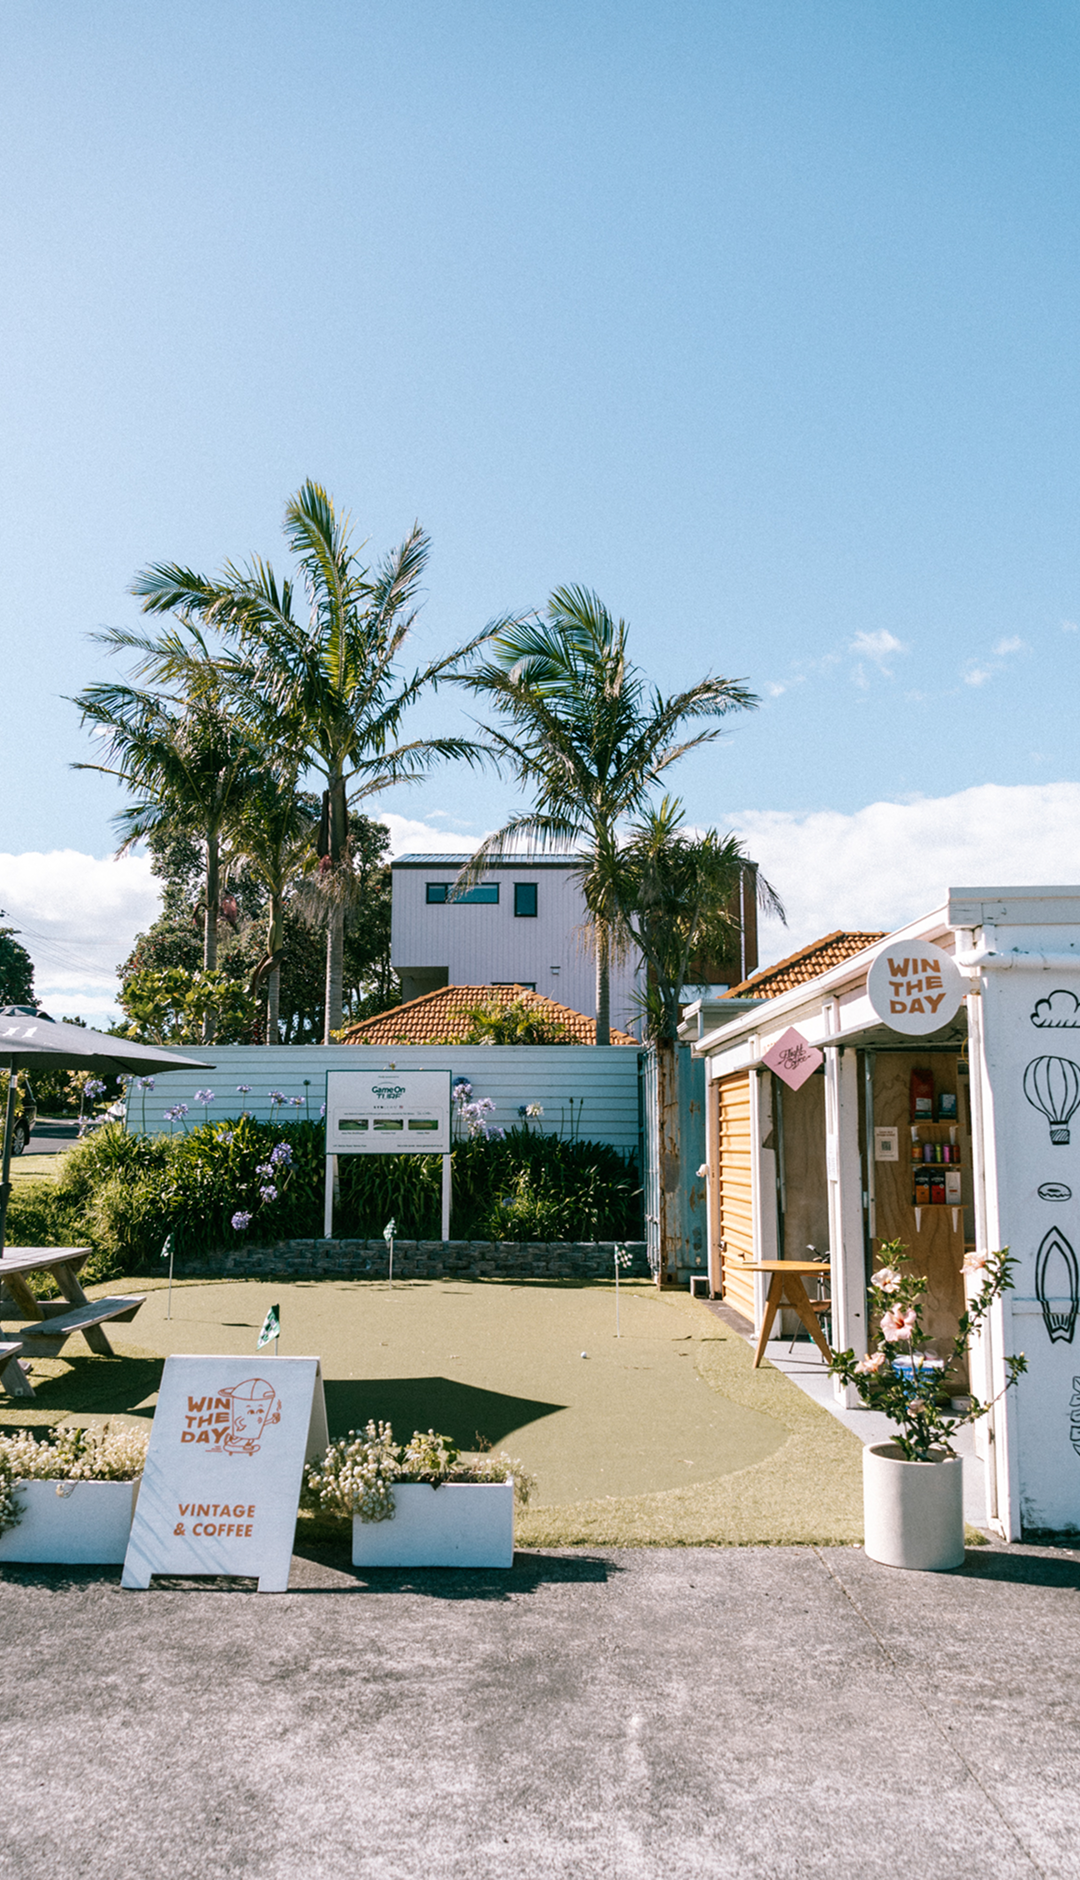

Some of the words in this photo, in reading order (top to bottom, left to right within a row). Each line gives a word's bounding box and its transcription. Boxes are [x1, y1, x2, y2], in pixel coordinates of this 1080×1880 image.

[887, 957, 941, 978] WIN
[888, 976, 943, 997] THE
[889, 992, 946, 1014] DAY
[187, 1396, 230, 1412] WIN
[184, 1411, 230, 1428] THE
[180, 1426, 230, 1444] DAY
[178, 1503, 256, 1518] VINTAGE
[173, 1523, 185, 1536] &
[192, 1523, 254, 1537] COFFEE
